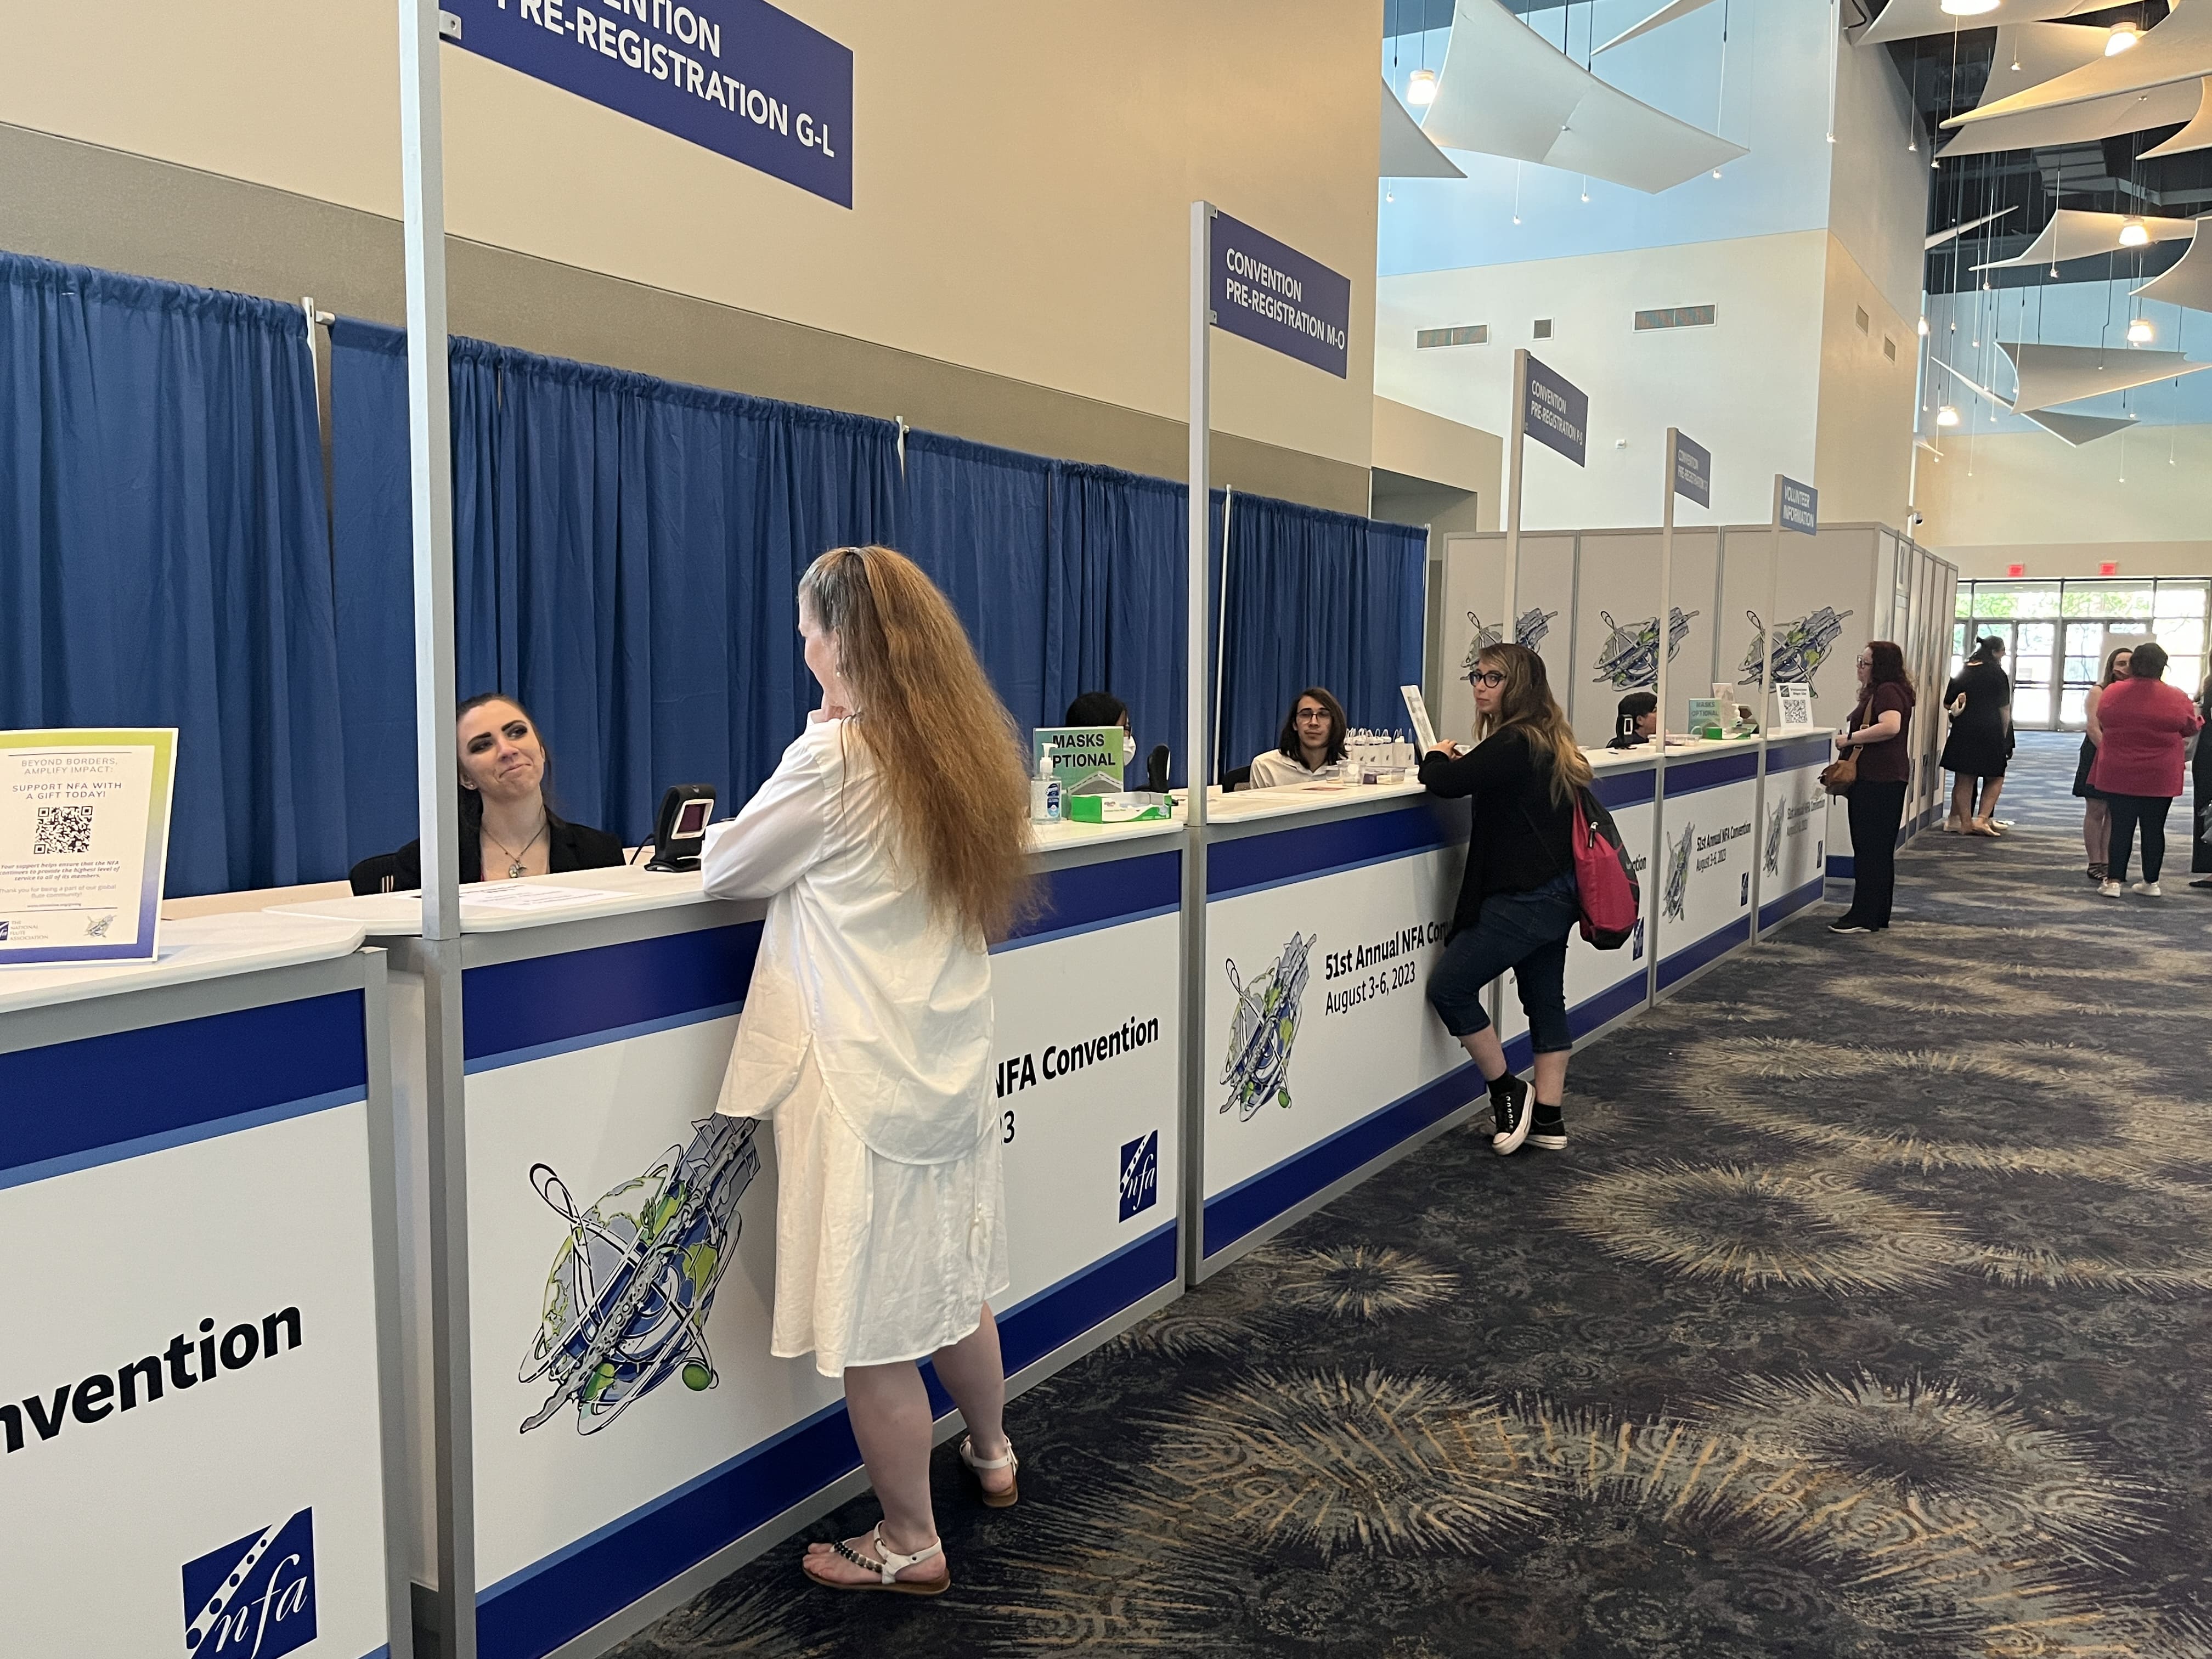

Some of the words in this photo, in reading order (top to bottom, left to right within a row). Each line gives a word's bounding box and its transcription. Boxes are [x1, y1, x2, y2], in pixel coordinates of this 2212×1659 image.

[796, 112, 834, 157] G-L
[1226, 247, 1302, 302] CONVENTION
[1226, 278, 1325, 341] PRE-REGISTRATION
[1327, 324, 1345, 349] M-O
[1531, 400, 1577, 441] PRE-REGISTRATION
[1532, 380, 1566, 415] CONVENTION
[21, 759, 63, 767] BEYOND
[1052, 733, 1104, 748] MASKS
[1052, 753, 1116, 768] PTIONAL
[13, 783, 63, 792] SUPPORT
[1325, 949, 1352, 980] 51st
[1356, 931, 1399, 970] Annual
[1402, 925, 1424, 955] NFA
[1325, 980, 1367, 1016] August
[1369, 972, 1389, 1000] 3-6,
[1392, 961, 1415, 990] 2023
[1042, 1016, 1159, 1080] Convention
[1127, 1154, 1155, 1211] nfa
[215, 1554, 308, 1659] nfa
